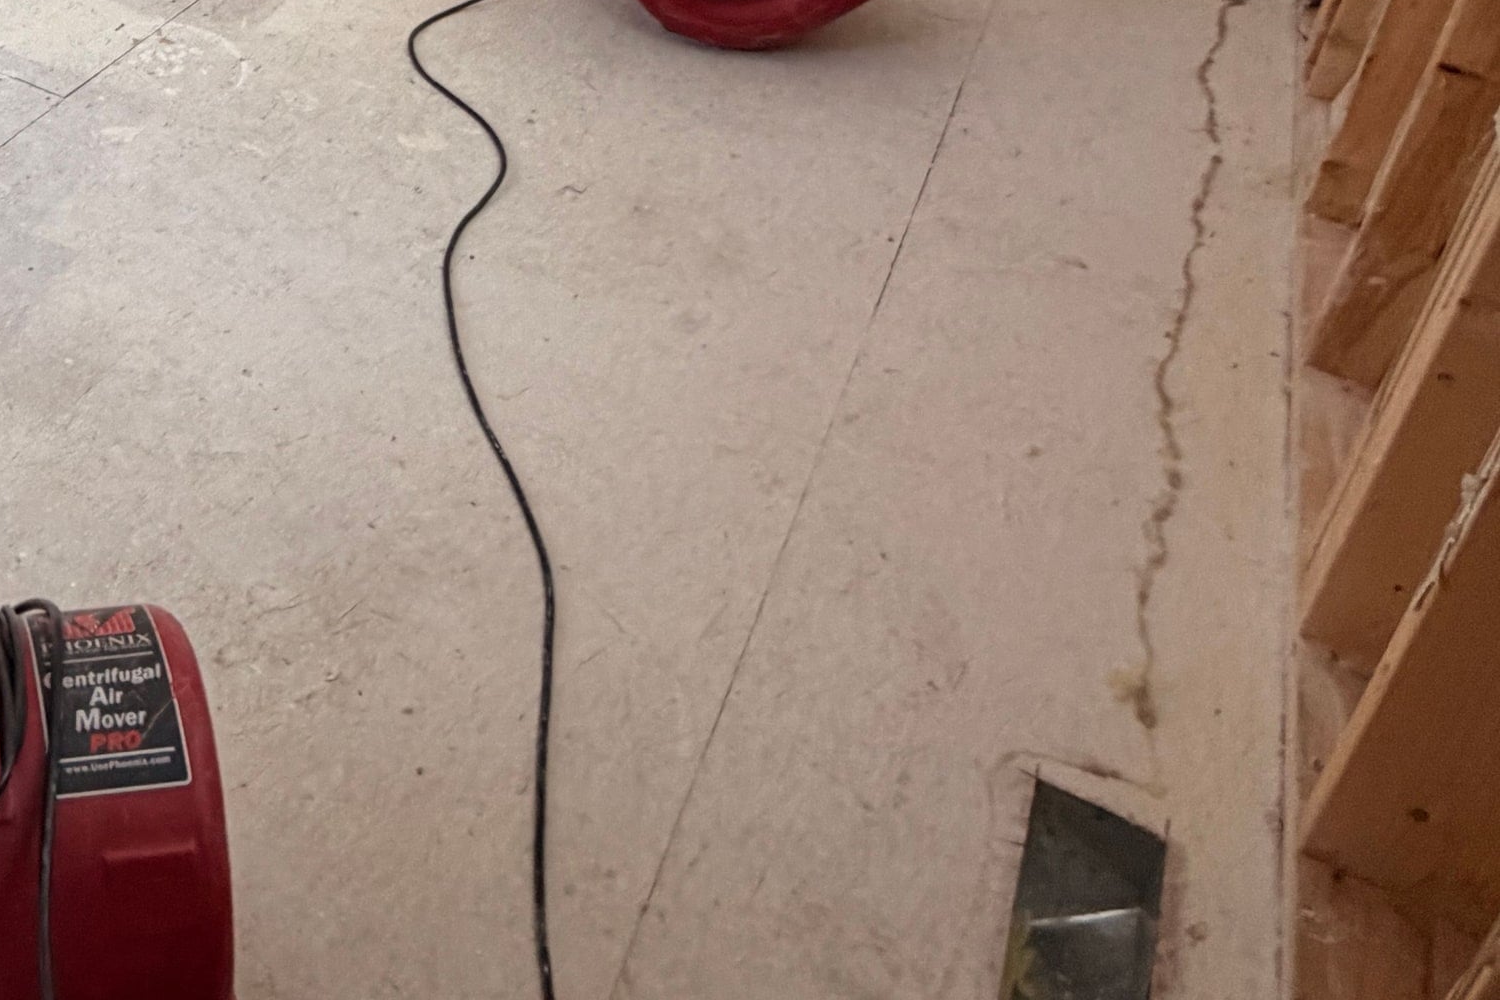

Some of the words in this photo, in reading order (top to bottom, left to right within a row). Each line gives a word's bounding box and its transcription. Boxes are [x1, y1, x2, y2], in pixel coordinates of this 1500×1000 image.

[89, 686, 124, 707] Air
[75, 707, 148, 733] Mover
[89, 729, 142, 754] PRO
